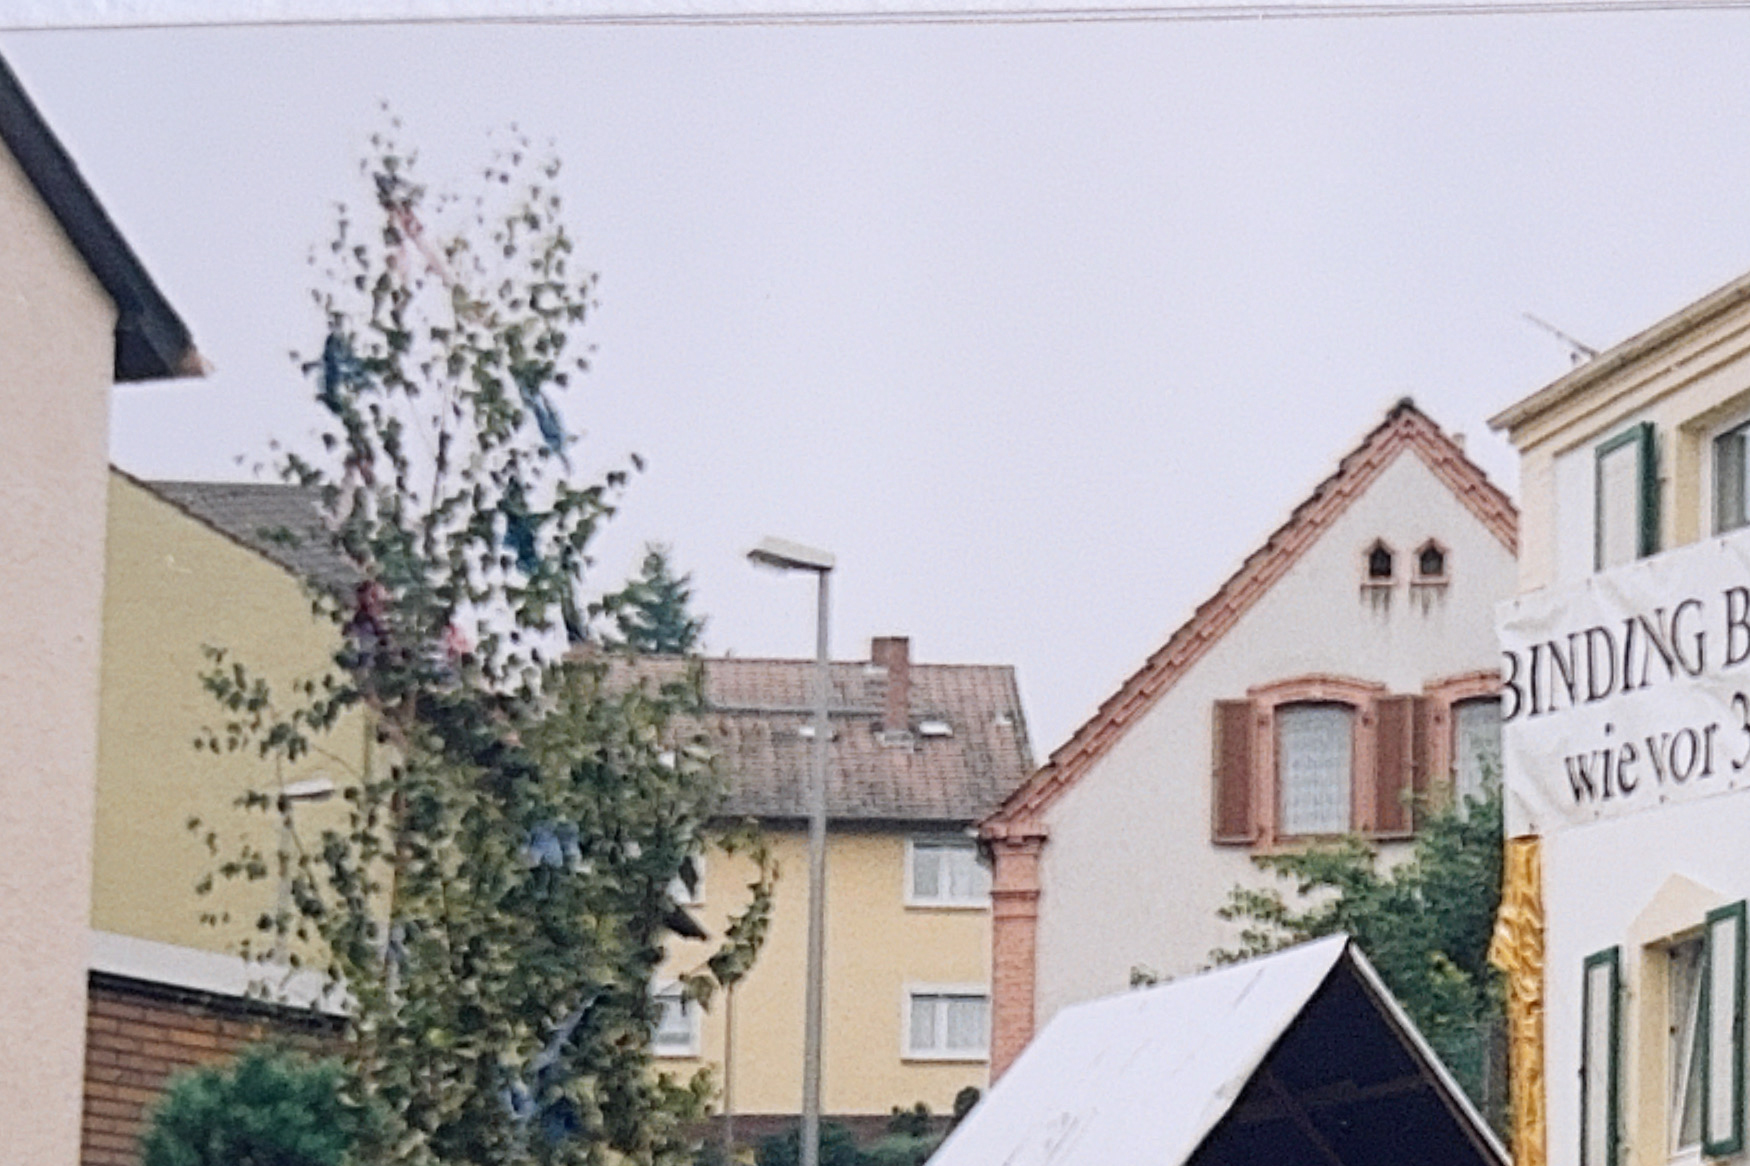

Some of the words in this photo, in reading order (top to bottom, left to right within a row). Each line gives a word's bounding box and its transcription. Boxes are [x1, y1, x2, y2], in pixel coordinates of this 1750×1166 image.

[1500, 599, 1704, 722] BINDING
[1565, 724, 1638, 803] wie
[1647, 722, 1719, 785] vor
